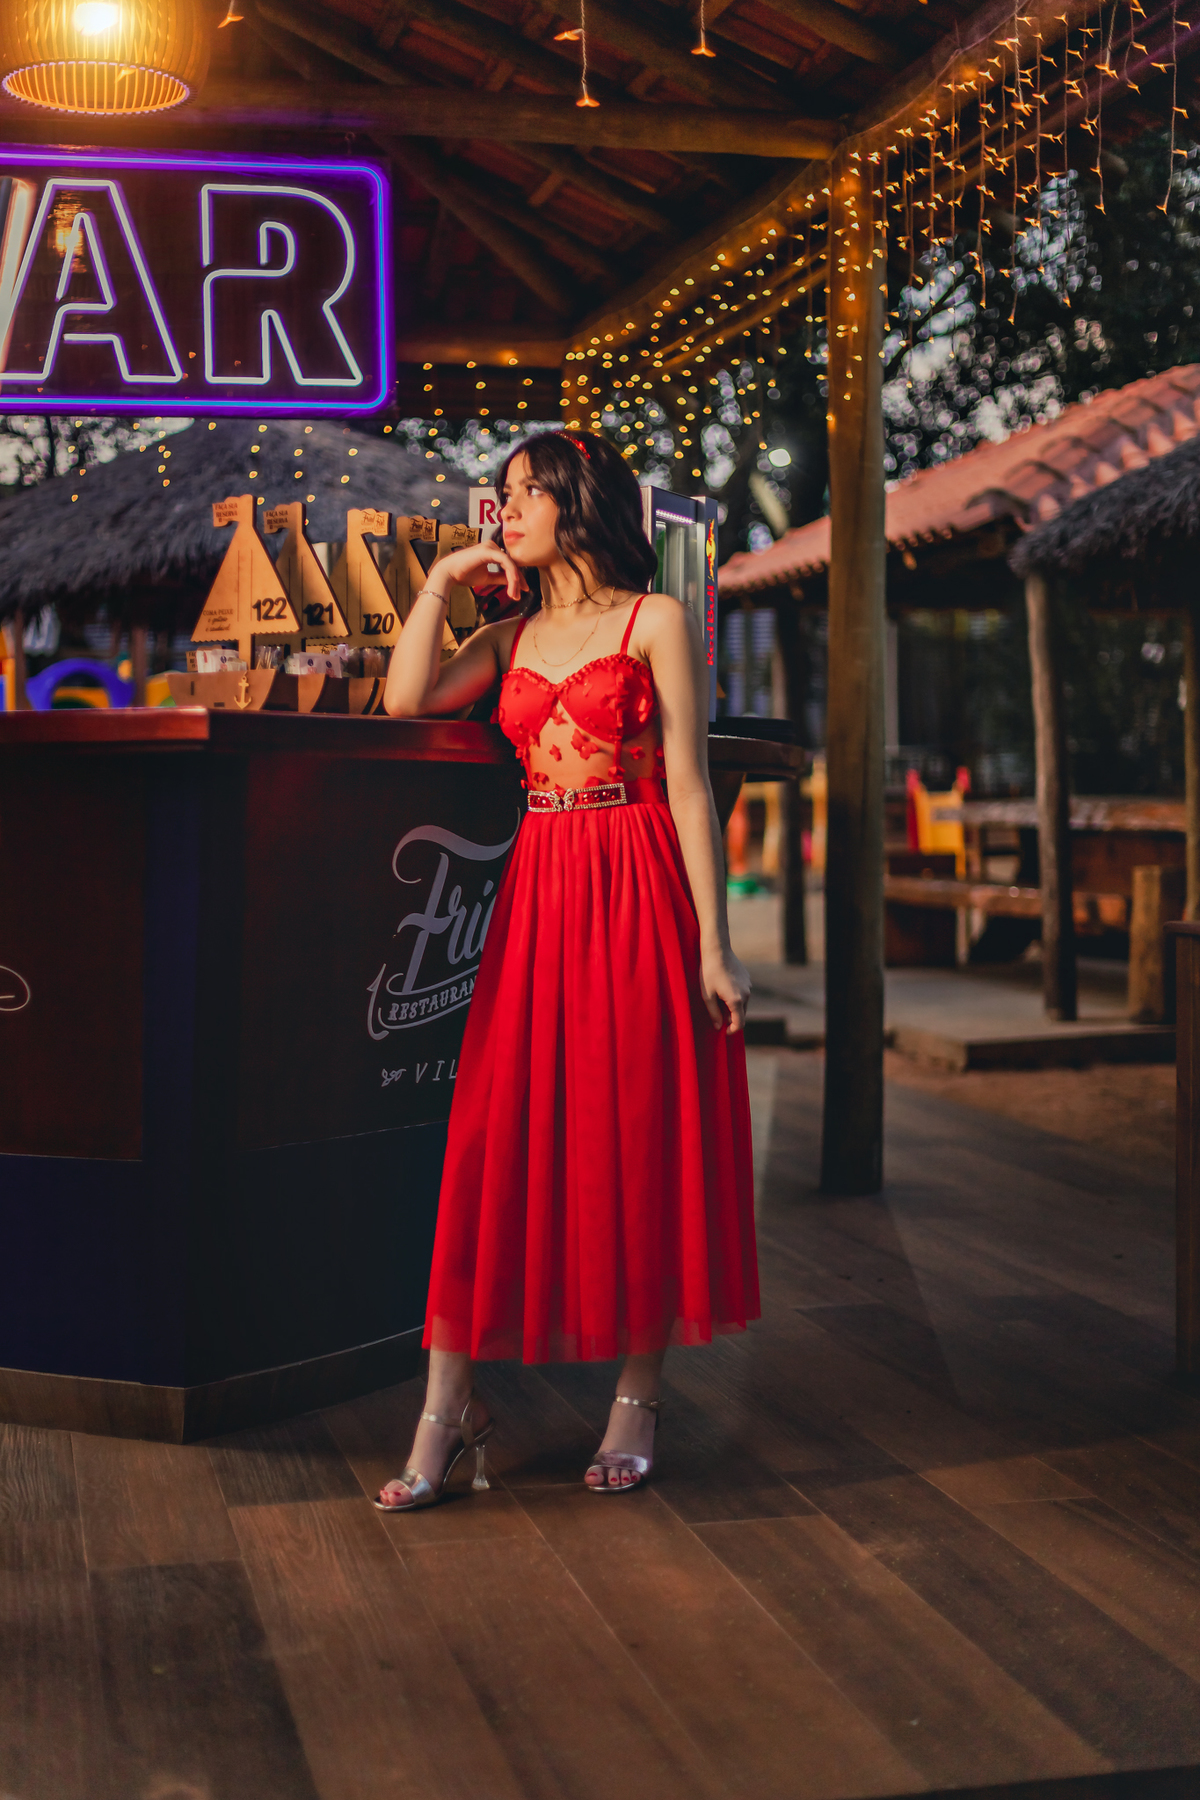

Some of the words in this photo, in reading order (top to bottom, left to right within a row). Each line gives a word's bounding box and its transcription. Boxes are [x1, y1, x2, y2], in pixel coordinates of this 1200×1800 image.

[479, 498, 502, 525] R
[252, 597, 287, 621] 122
[303, 602, 334, 626] 121
[706, 585, 715, 624] Bull
[361, 612, 395, 635] 120
[706, 626, 715, 666] Red
